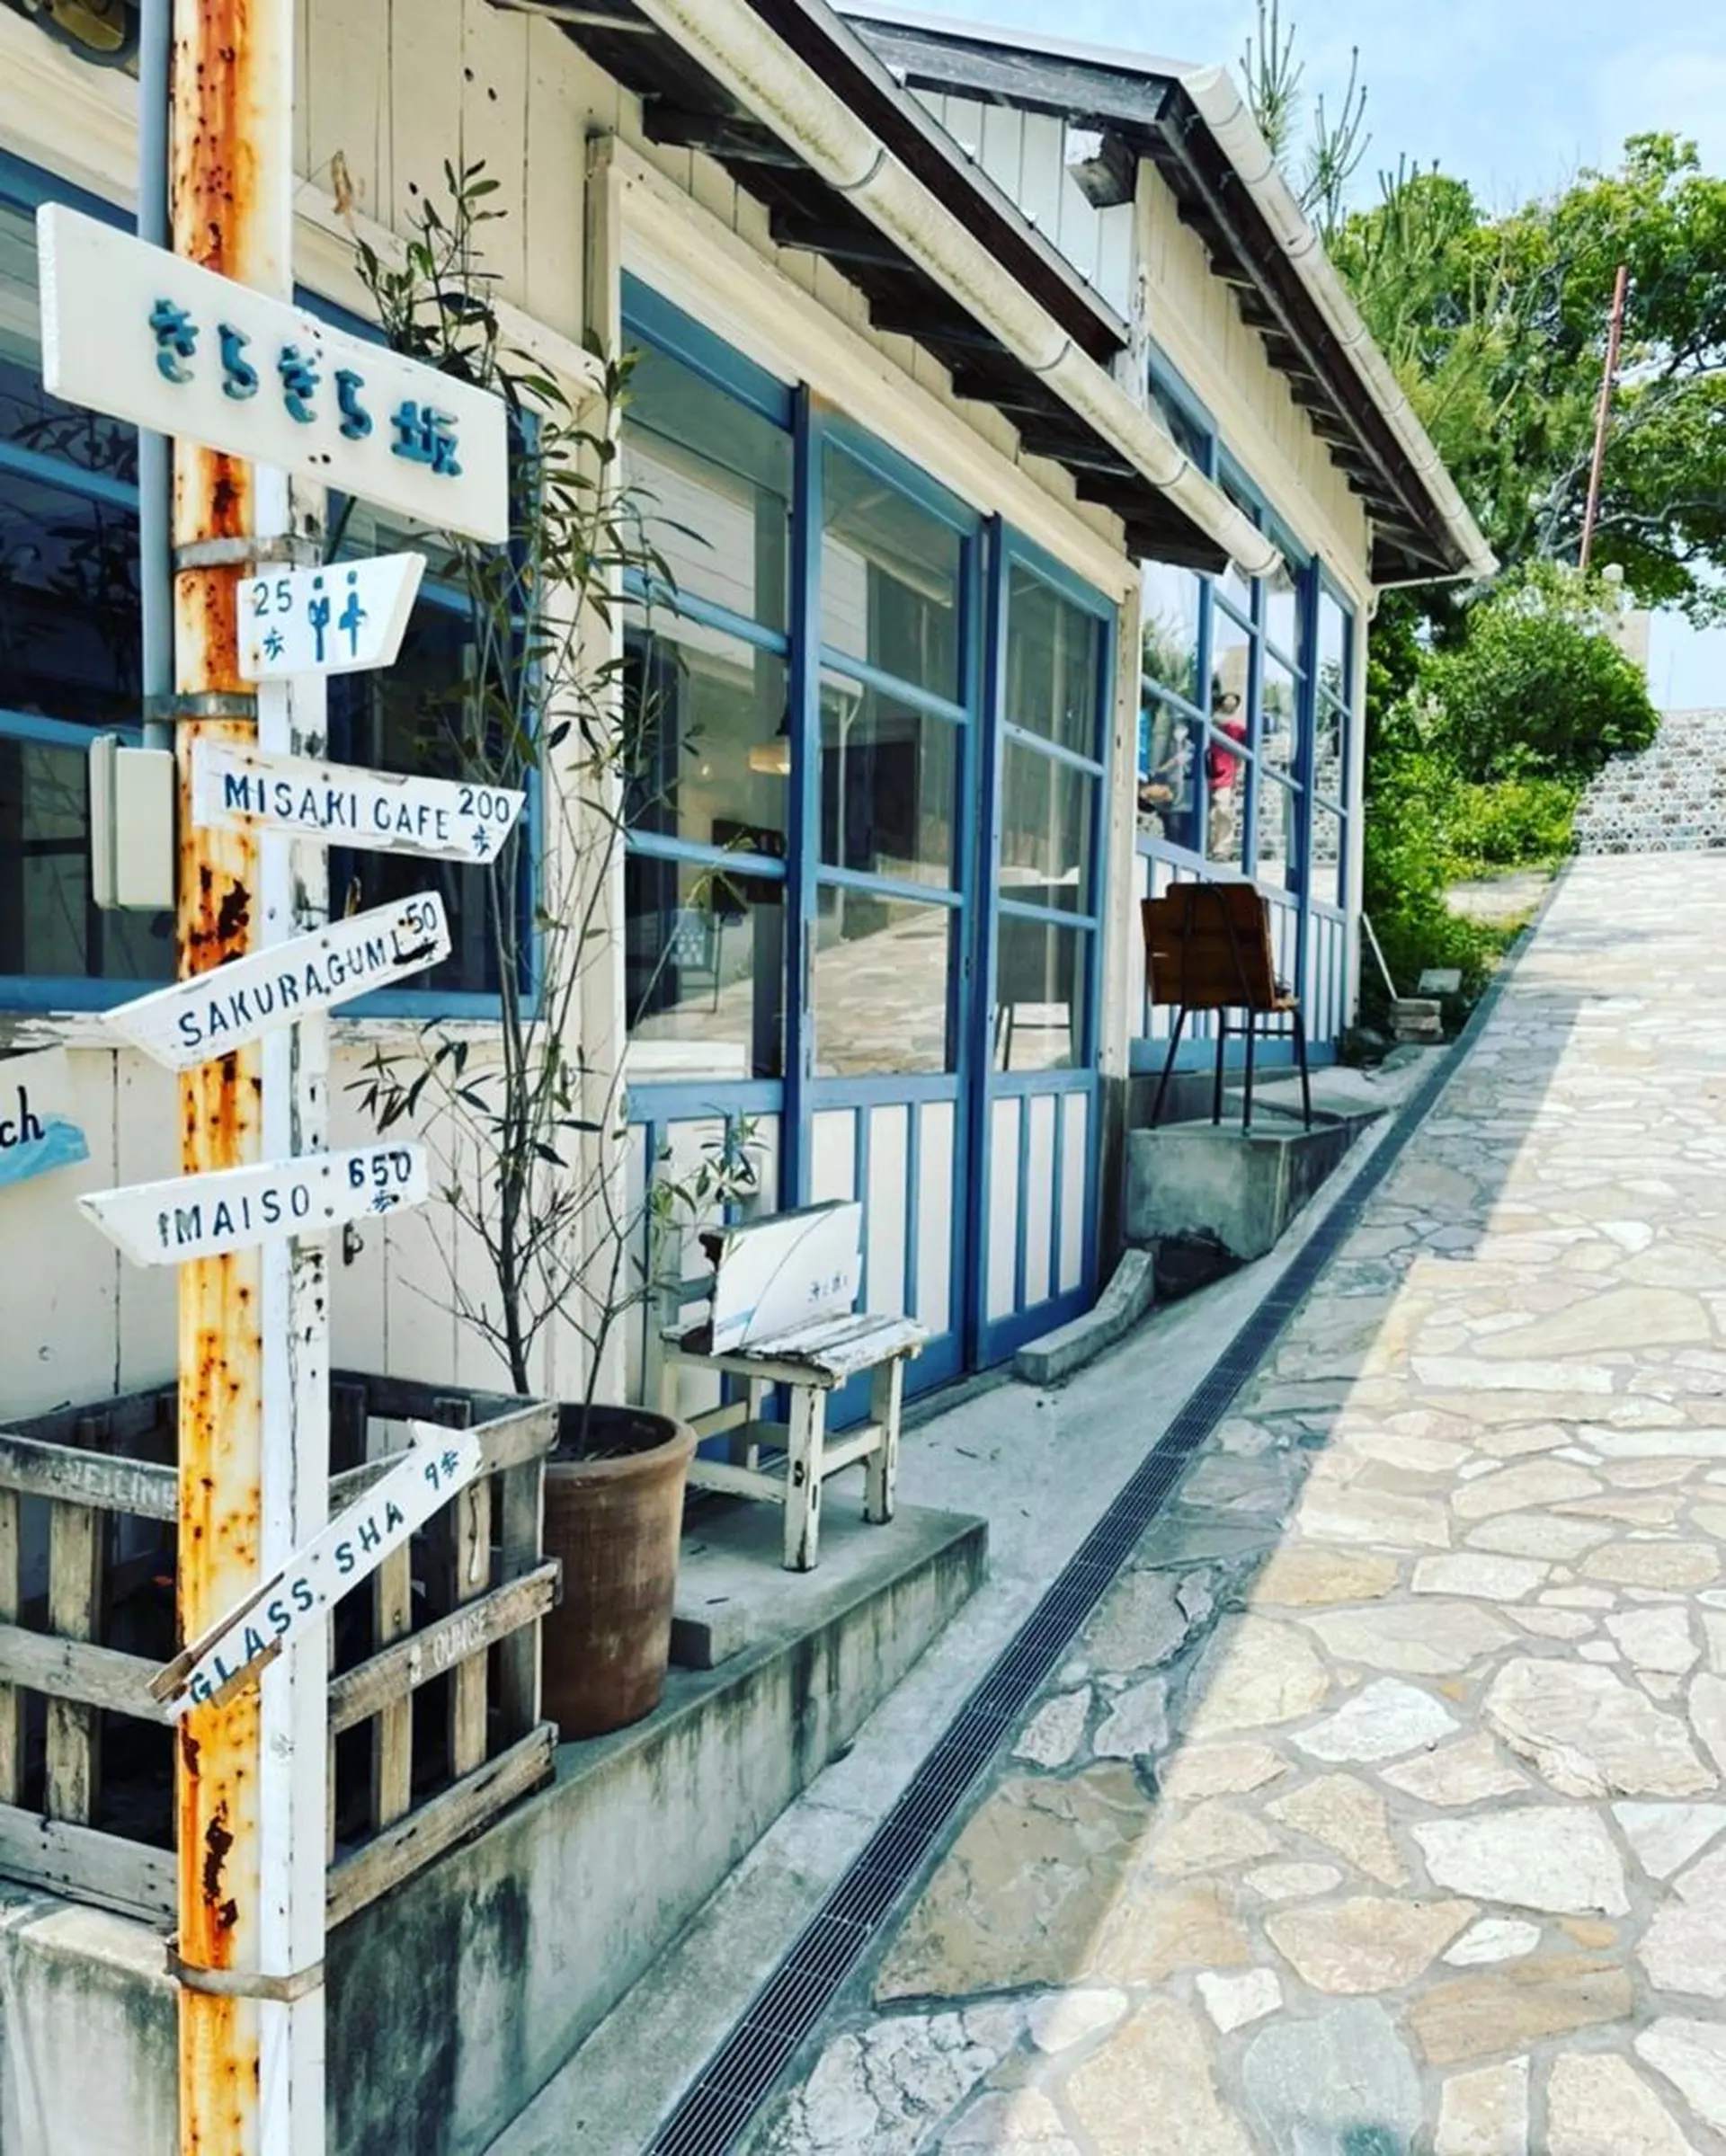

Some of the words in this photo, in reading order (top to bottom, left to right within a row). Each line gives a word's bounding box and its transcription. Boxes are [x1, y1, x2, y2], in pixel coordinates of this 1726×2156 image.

[149, 298, 462, 478] きらきら坂
[253, 578, 293, 617] 25
[262, 626, 286, 661] 歩
[226, 773, 357, 829] MISAKI
[374, 796, 449, 841] CAFE
[458, 787, 511, 824] 200
[179, 929, 402, 1048] SAKURAGUMI
[405, 901, 437, 935] 50
[157, 1184, 310, 1248] IMAISO
[348, 1150, 413, 1188] 650
[189, 1578, 313, 1705] GLASS
[334, 1501, 405, 1574] SHA
